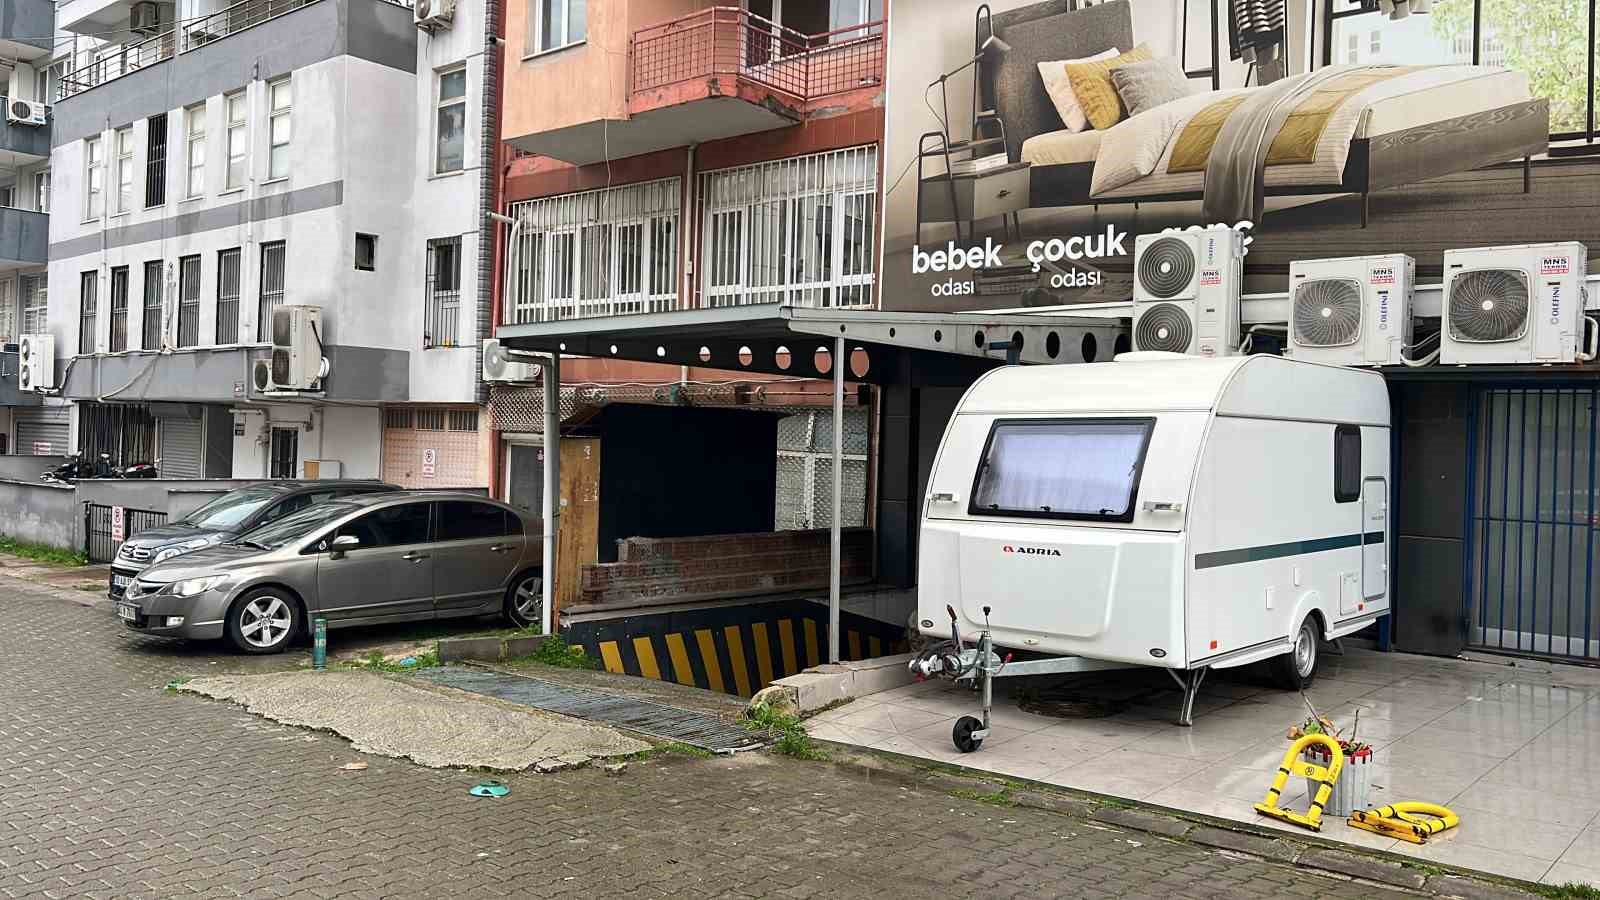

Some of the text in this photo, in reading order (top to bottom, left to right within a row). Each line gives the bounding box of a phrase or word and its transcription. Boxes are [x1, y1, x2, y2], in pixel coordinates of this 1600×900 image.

[912, 236, 1003, 274] bebek
[1026, 223, 1128, 272] çocuk
[1543, 258, 1567, 266] MNS
[931, 277, 975, 297] odası
[1050, 267, 1101, 288] odası
[1017, 547, 1061, 556] ADRIA
